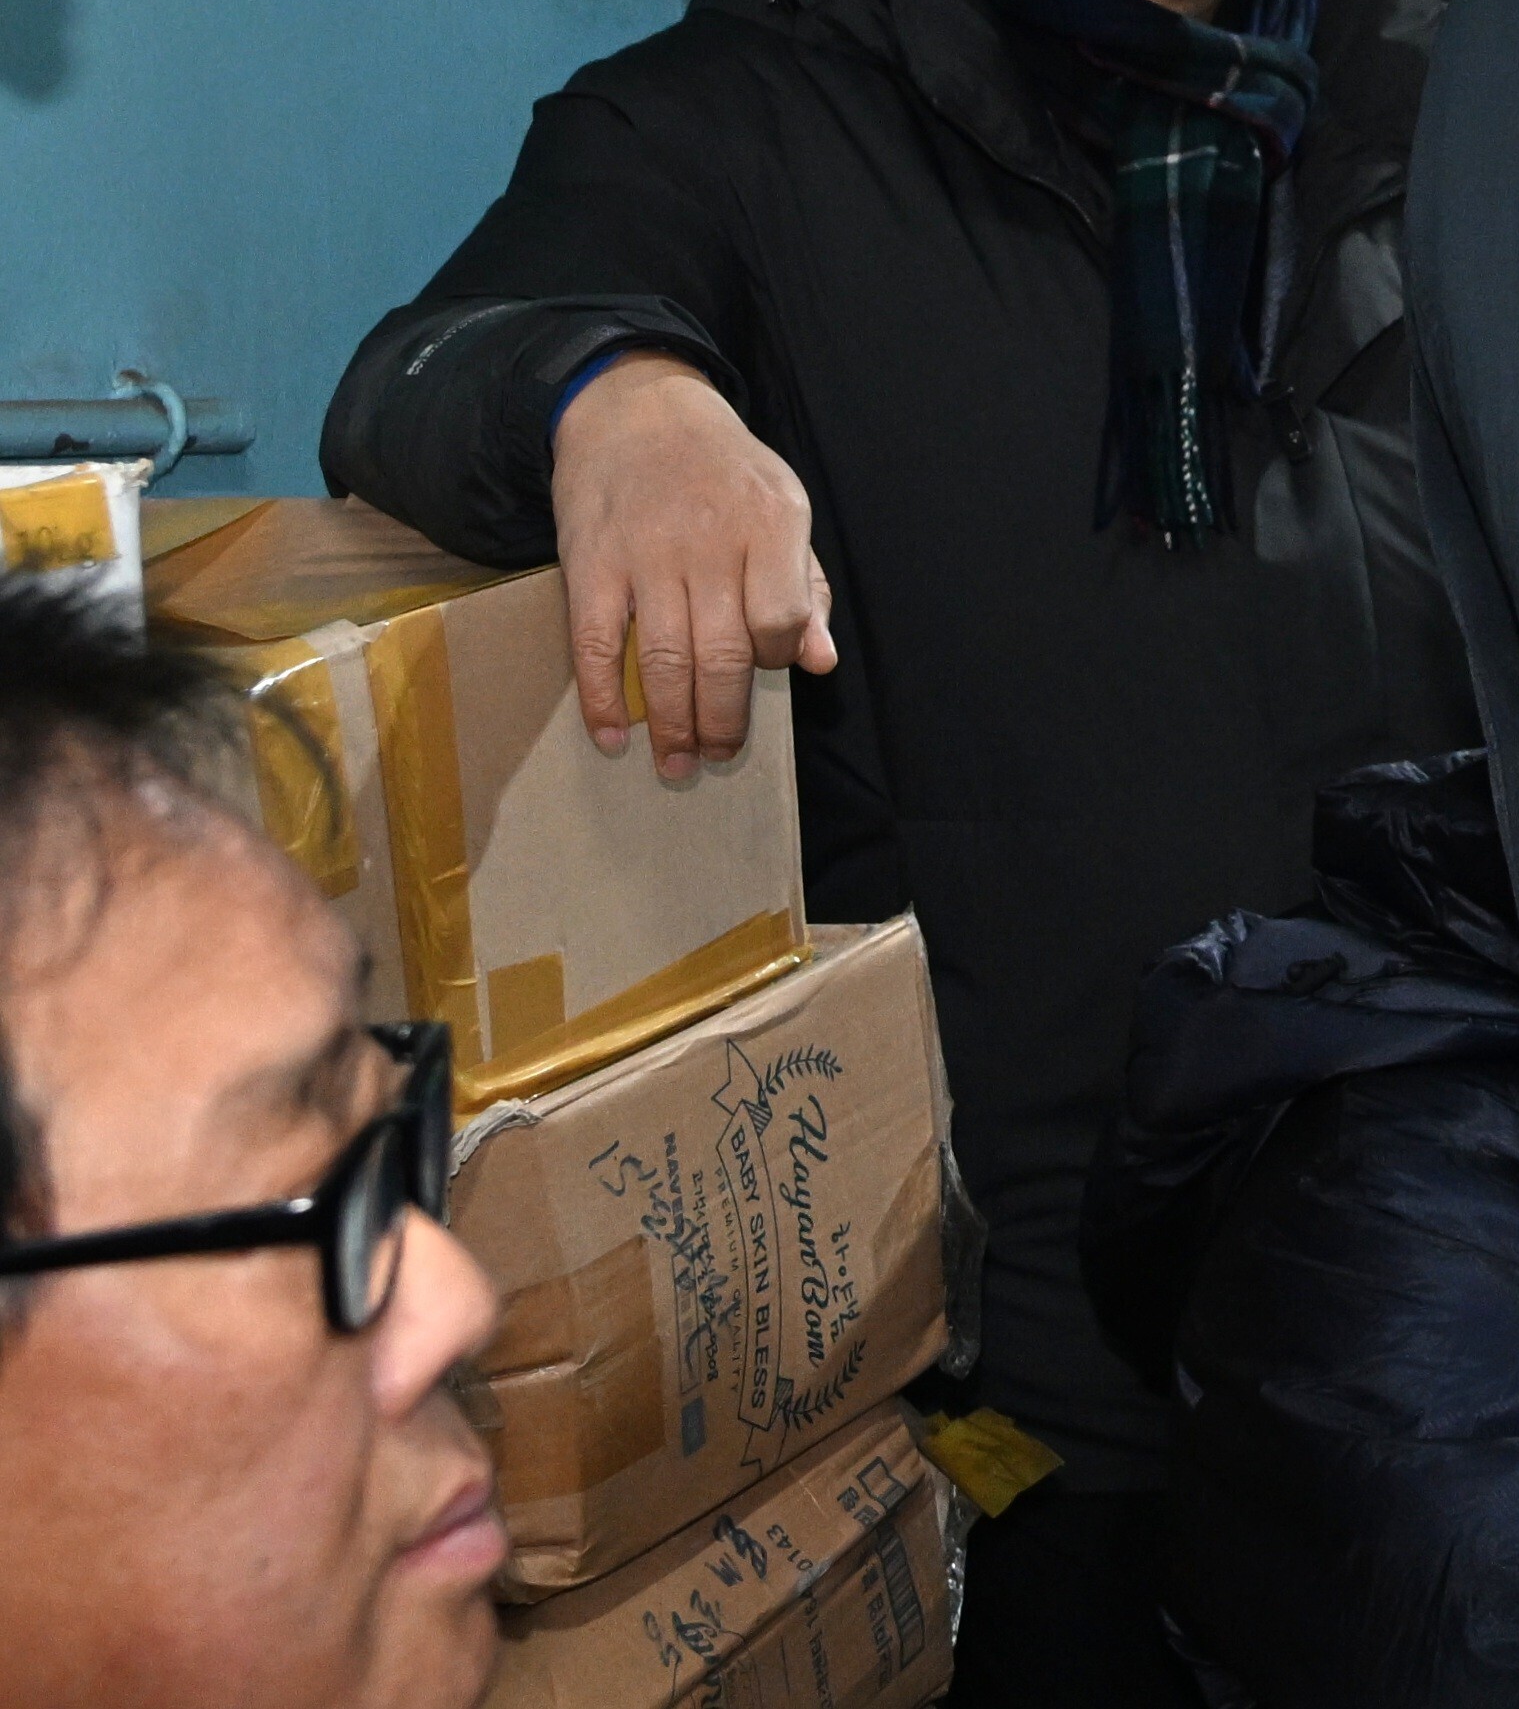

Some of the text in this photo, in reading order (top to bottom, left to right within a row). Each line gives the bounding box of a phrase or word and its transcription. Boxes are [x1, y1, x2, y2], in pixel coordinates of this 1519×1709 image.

[714, 1166, 740, 1273] PREMIUM
[730, 1124, 771, 1410] BABY SKIN BLESS
